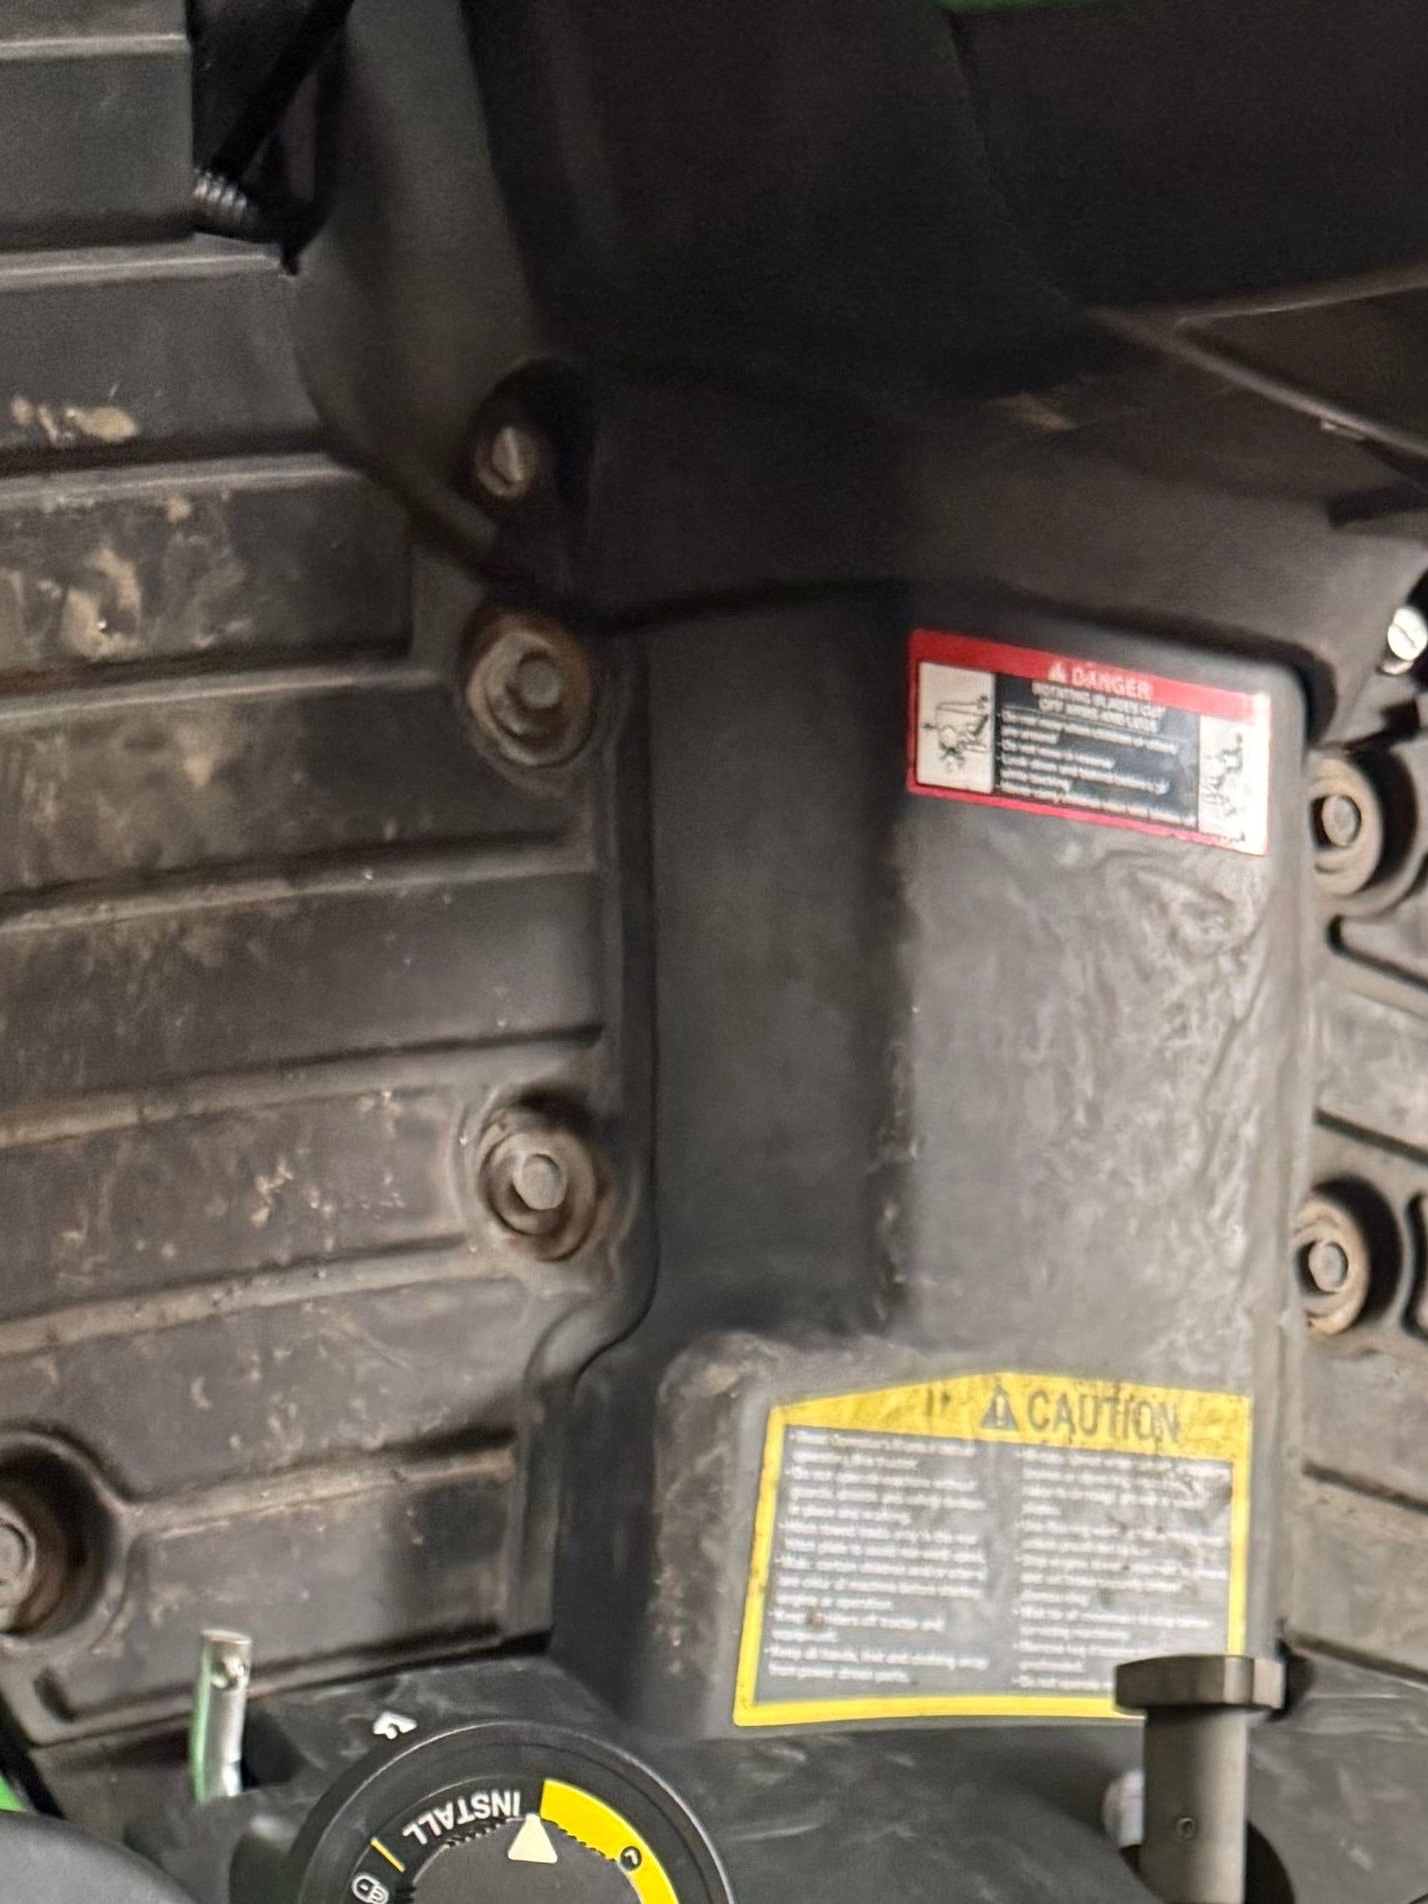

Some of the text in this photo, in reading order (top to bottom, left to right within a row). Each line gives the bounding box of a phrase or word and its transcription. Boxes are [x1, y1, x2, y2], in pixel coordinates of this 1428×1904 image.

[1072, 667, 1152, 695] DANGER
[1027, 1387, 1181, 1443] CAUTION
[402, 1790, 521, 1846] INSTALL
